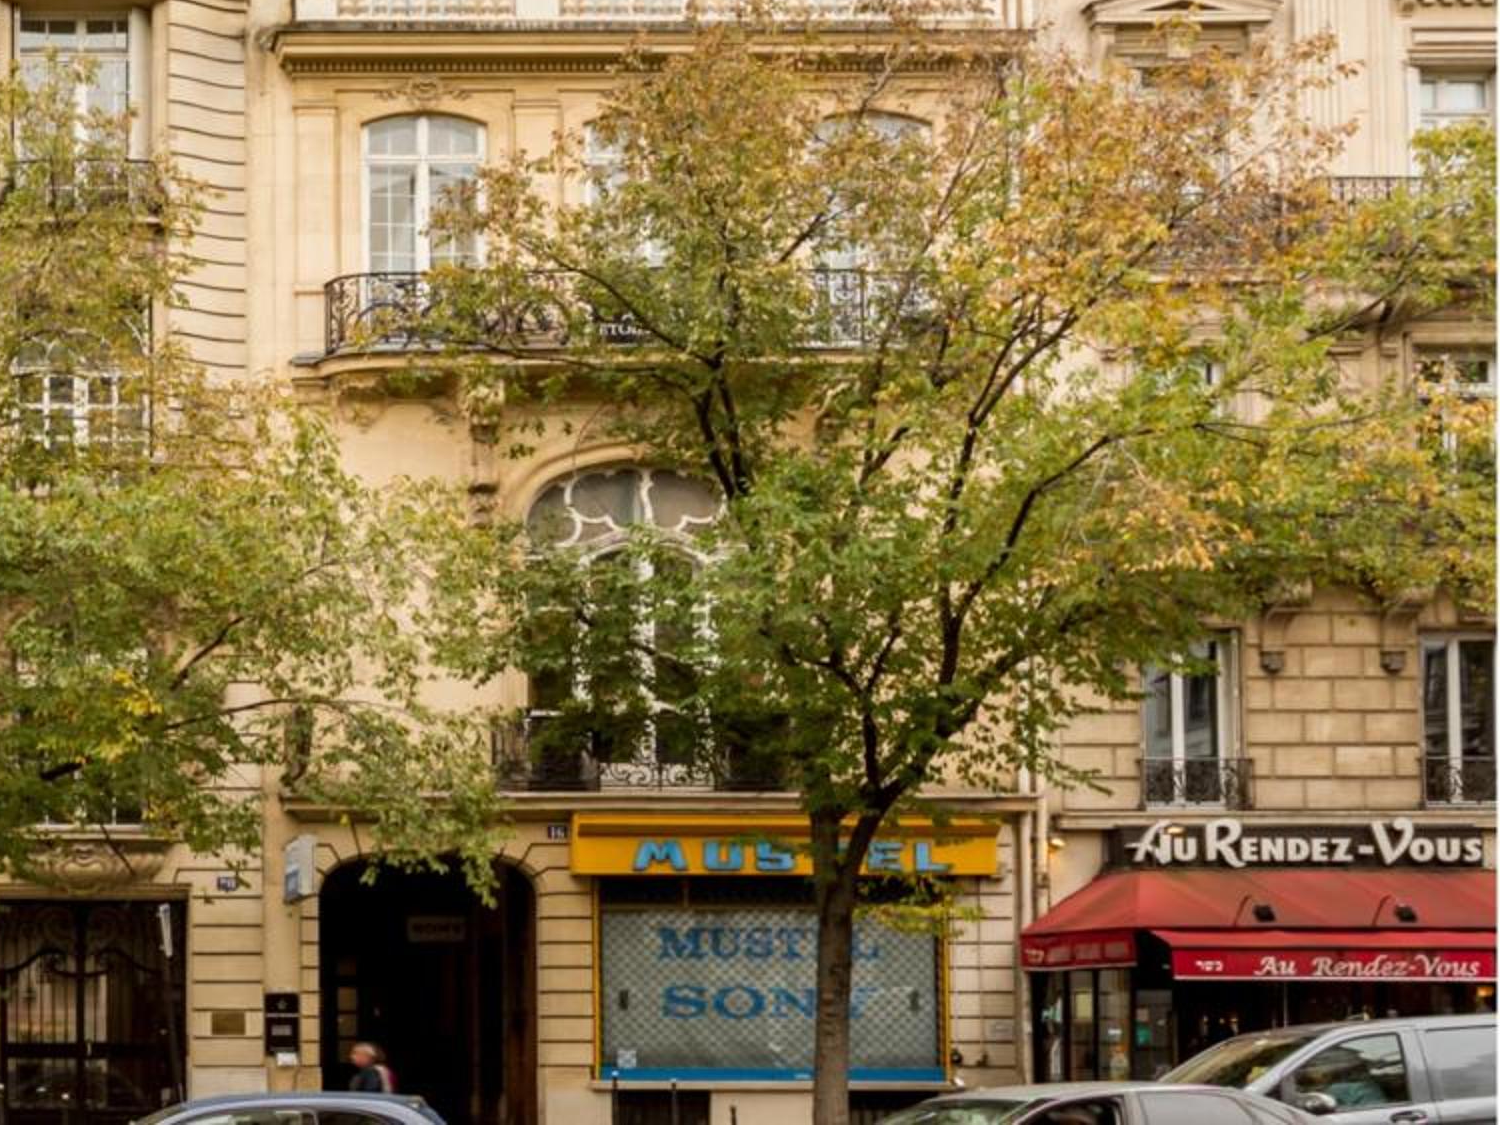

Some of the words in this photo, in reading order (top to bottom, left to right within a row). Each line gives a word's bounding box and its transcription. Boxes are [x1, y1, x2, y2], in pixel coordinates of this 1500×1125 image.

[633, 837, 953, 872] MUSEL
[658, 927, 880, 962] MUSTL
[1254, 955, 1298, 976] Au
[1312, 954, 1481, 977] Rendez-Vous
